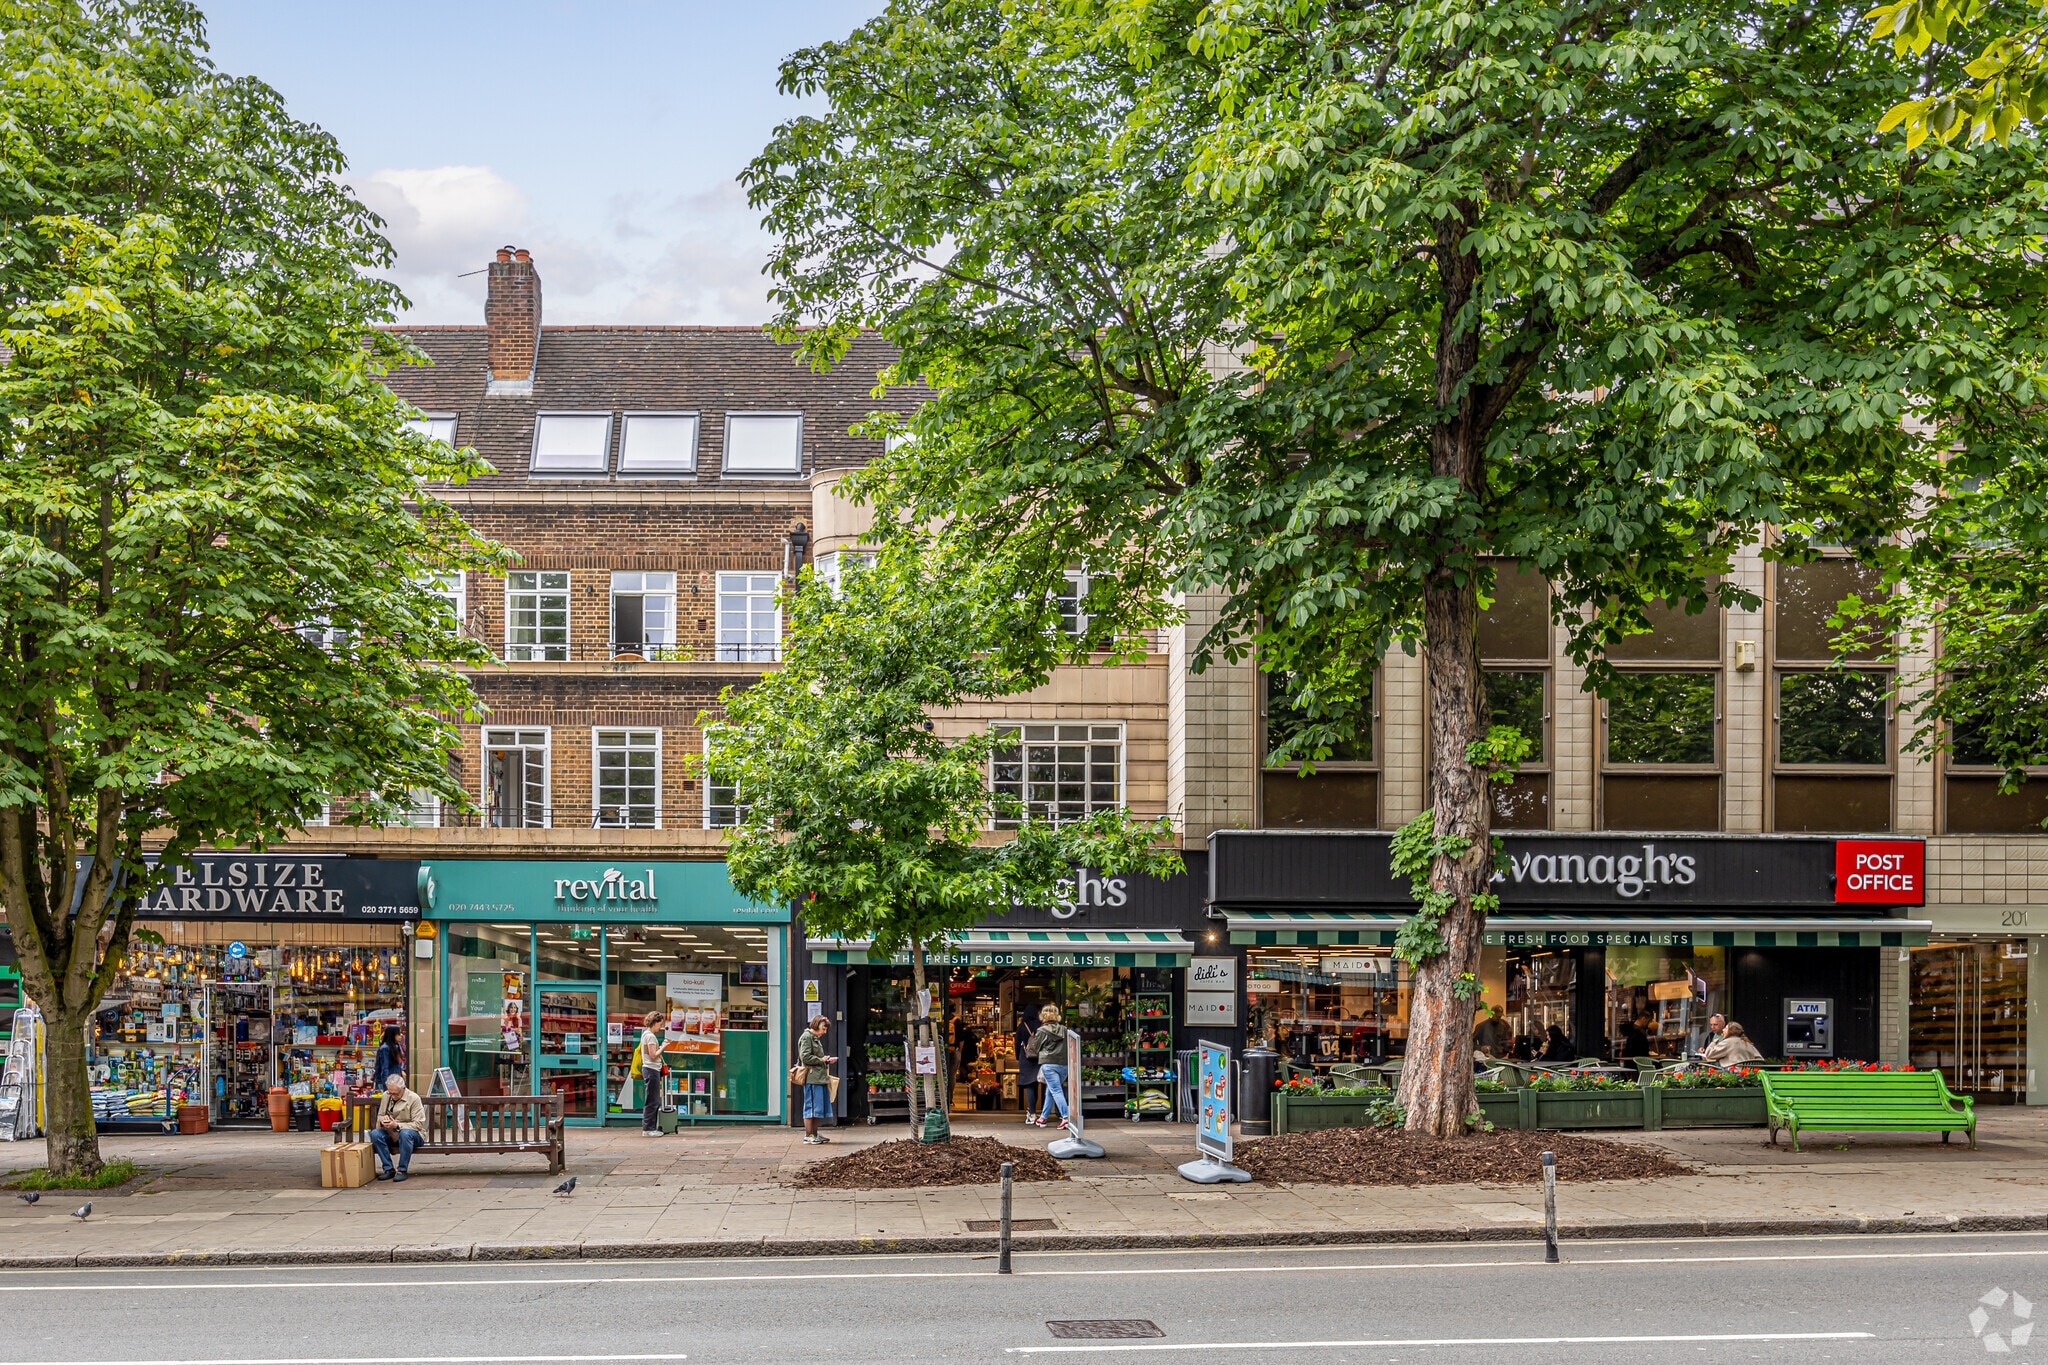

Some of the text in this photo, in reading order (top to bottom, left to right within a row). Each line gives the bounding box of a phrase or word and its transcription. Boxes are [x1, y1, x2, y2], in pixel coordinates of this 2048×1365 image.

[1856, 854, 1904, 870] POST
[145, 861, 324, 888] ELSIZE
[1847, 874, 1913, 890] OFFICE
[554, 868, 658, 900] revital
[448, 904, 466, 912] 020
[470, 904, 490, 912] 7443
[558, 904, 596, 914] thinking
[598, 904, 606, 912] of
[630, 904, 658, 912] health
[2001, 910, 2028, 926] 201
[1482, 935, 1688, 944] E FRESH FOOD SPECIALISTS
[894, 954, 1110, 964] TH FRESH FOOD SPECIALISTS
[1194, 964, 1228, 980] didi's
[1321, 1040, 1340, 1056] 04
